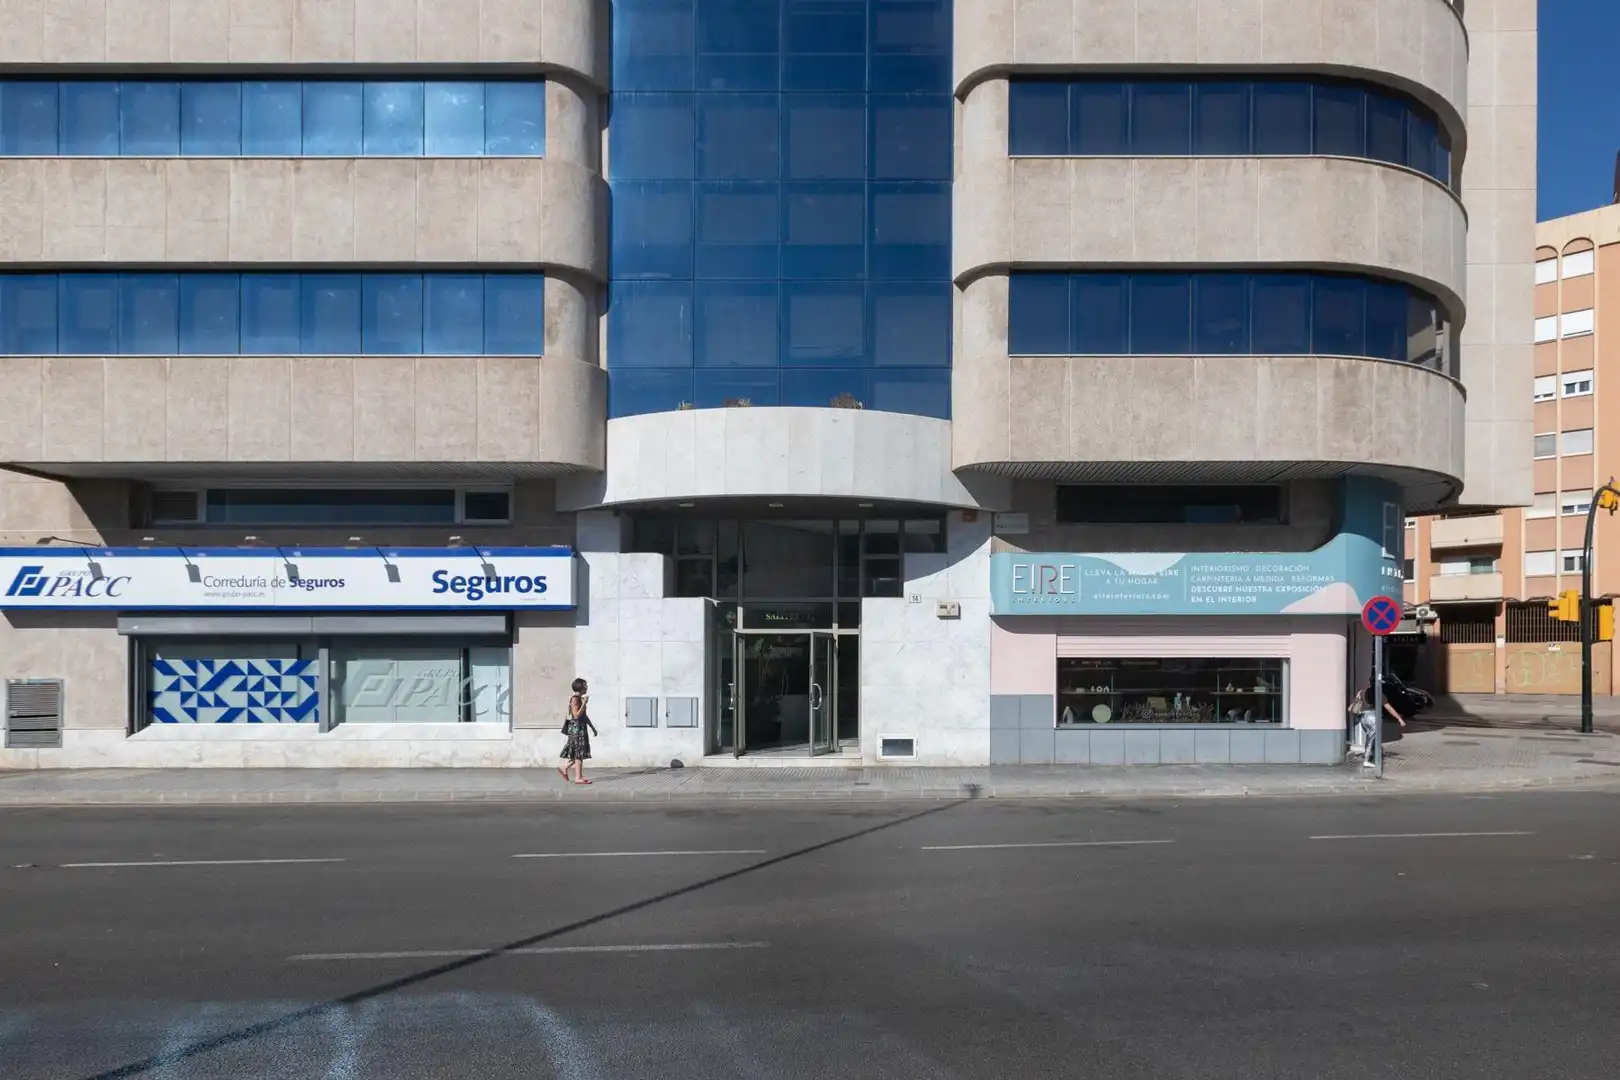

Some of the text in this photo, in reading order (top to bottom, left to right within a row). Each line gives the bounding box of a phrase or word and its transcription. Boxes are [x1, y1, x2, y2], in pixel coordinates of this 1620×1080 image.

[1085, 569, 1112, 577] LLEVA
[1114, 569, 1125, 577] LA
[1191, 564, 1250, 572] INTERIORISMO
[203, 575, 345, 591] Correduría de Seguros
[432, 569, 547, 601] Seguros
[1013, 564, 1075, 595] EIRE
[45, 576, 132, 597] PACC
[1191, 585, 1233, 593] DESCUBRE
[1235, 585, 1273, 593] NUESTRA
[1191, 595, 1257, 603] EN EL INTERIOR
